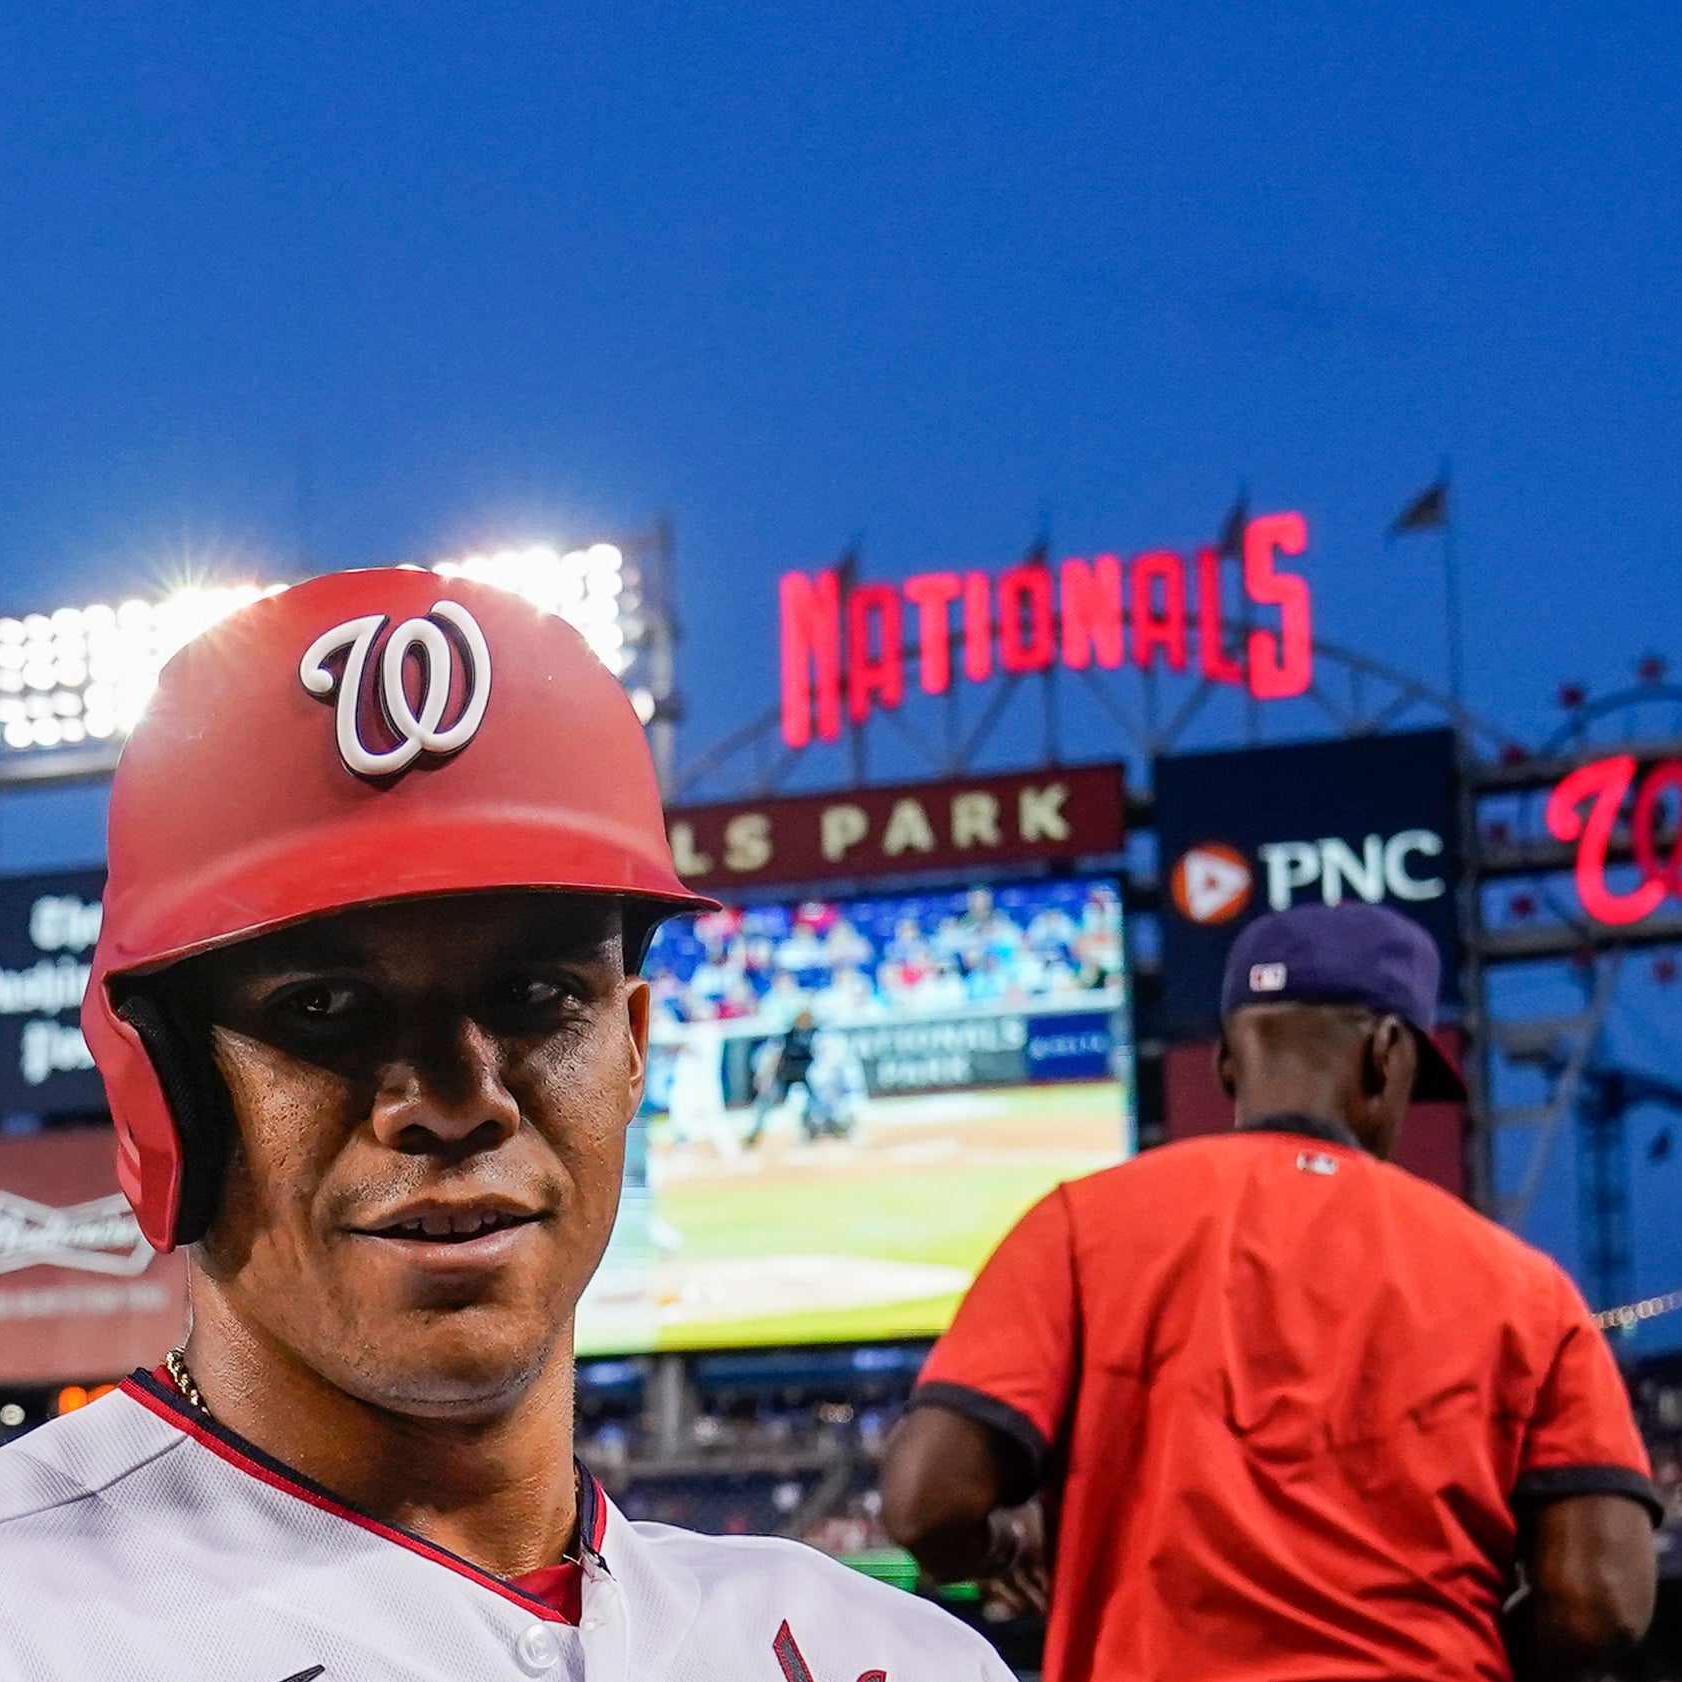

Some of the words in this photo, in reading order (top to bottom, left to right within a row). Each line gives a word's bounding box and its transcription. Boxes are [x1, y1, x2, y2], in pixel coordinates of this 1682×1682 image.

[299, 600, 491, 777] W
[778, 510, 1314, 748] NATIONALS
[820, 782, 1071, 863] PARK
[1258, 829, 1445, 912] PNC
